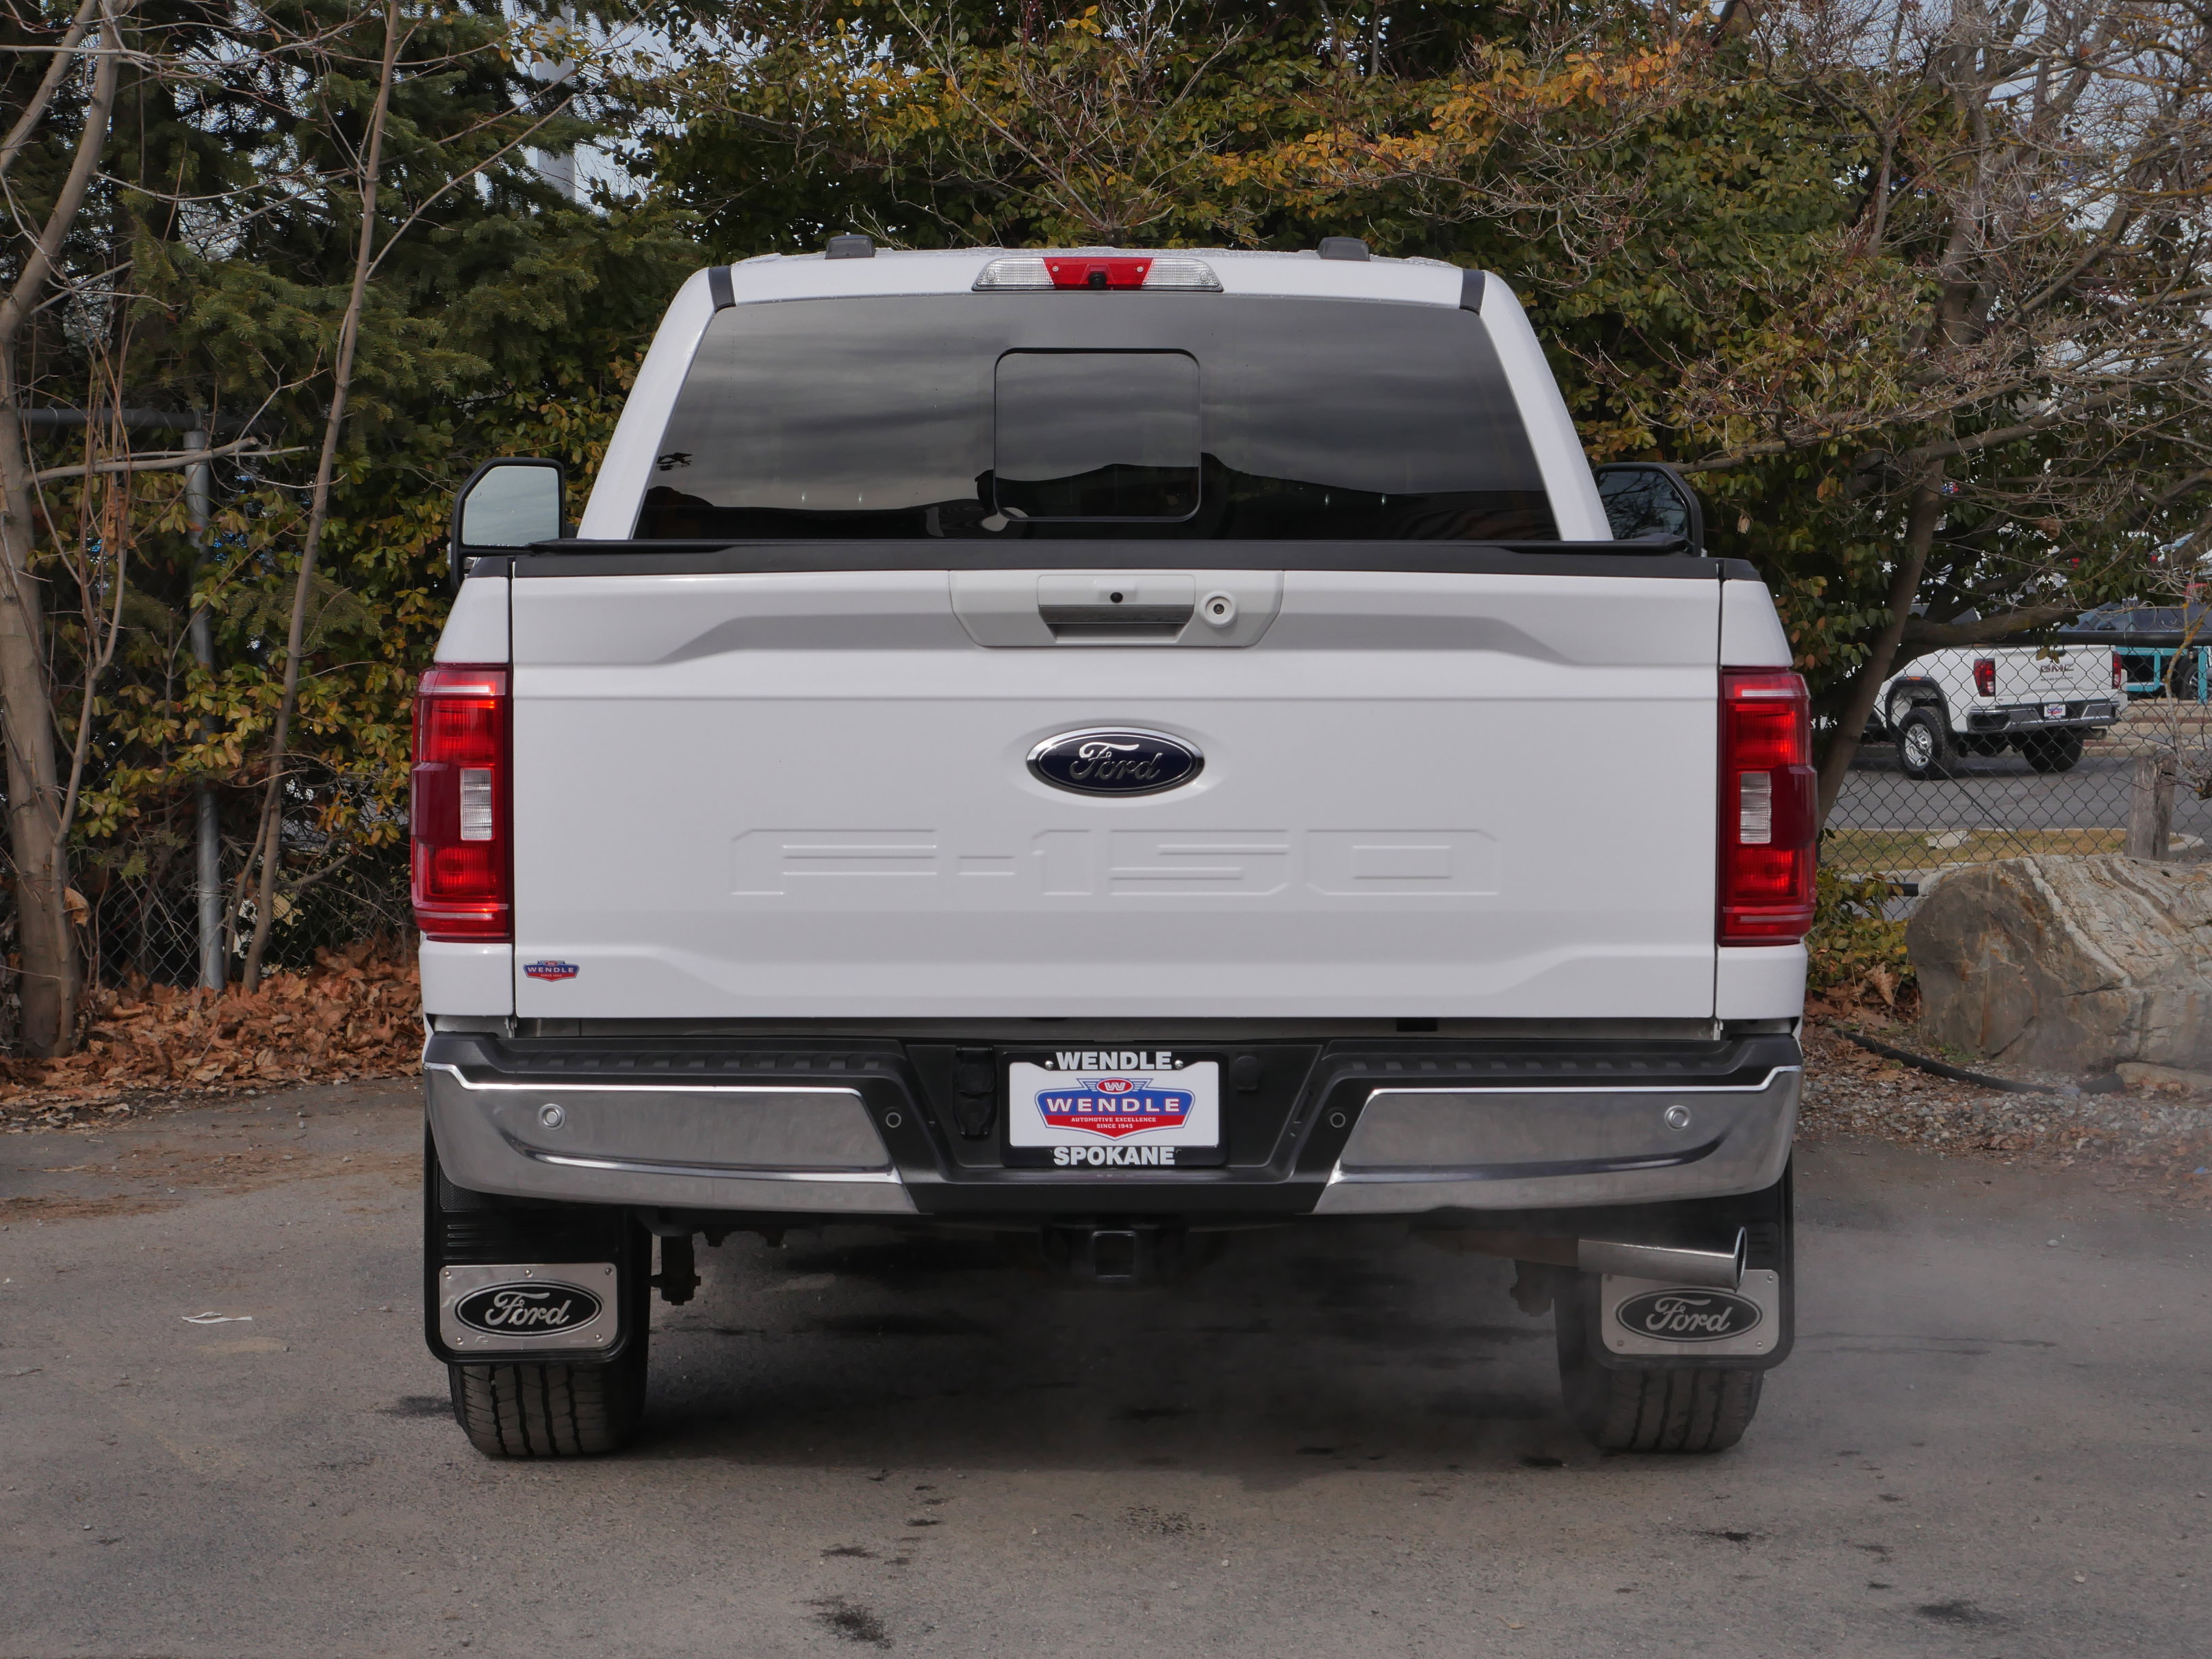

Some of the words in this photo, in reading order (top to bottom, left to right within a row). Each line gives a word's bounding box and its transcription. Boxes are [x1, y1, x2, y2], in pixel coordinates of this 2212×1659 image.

[1070, 741, 1163, 780] Ford
[730, 827, 1500, 896] F-150
[1056, 1051, 1172, 1070] WENDLE
[1046, 1098, 1181, 1112] WENDLE
[1053, 1146, 1175, 1166] SPOKANE
[485, 1291, 572, 1326] Ford
[1645, 1296, 1734, 1332] Ford
